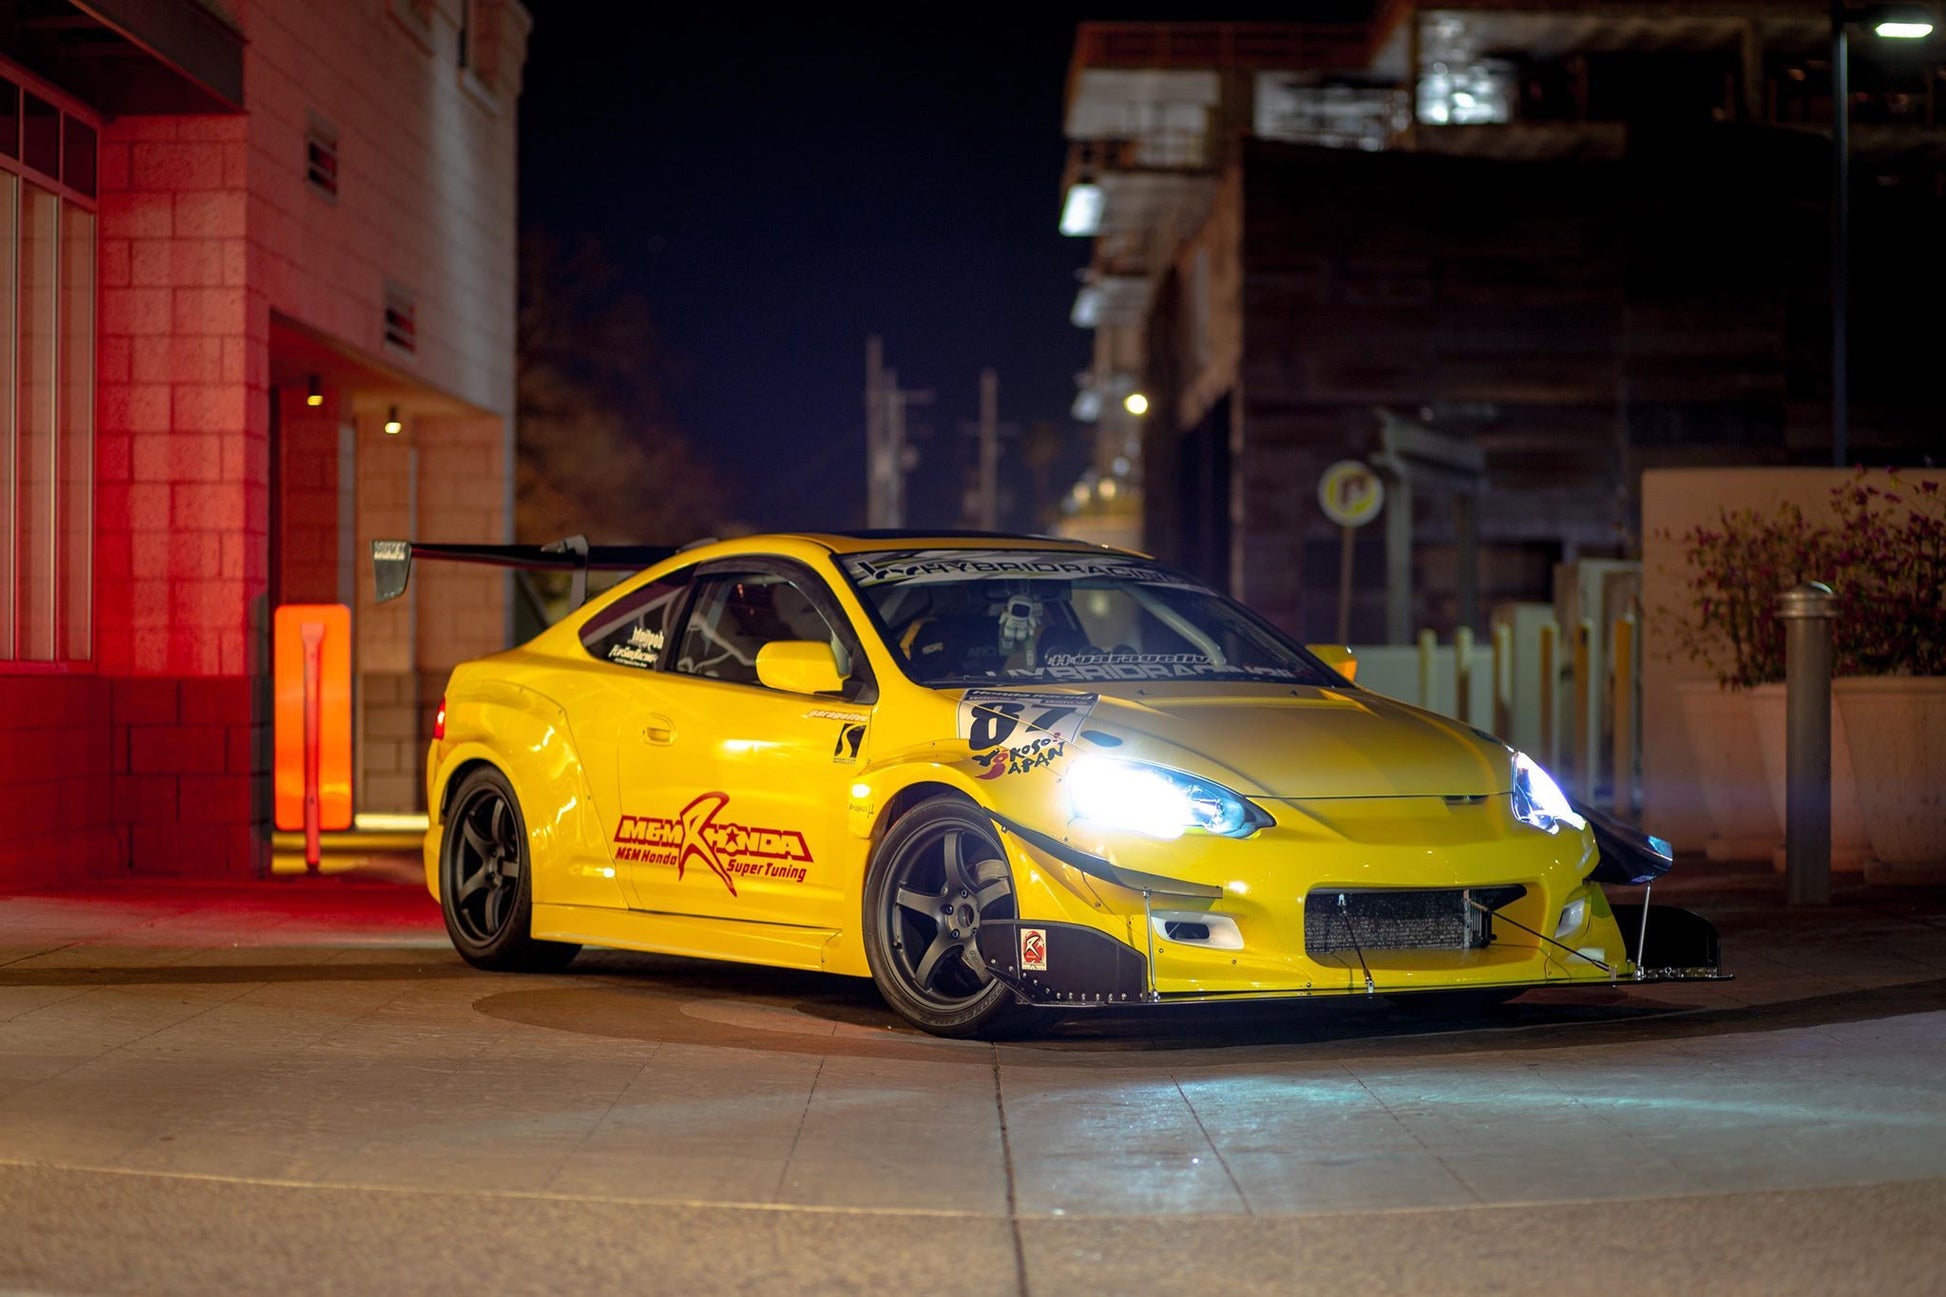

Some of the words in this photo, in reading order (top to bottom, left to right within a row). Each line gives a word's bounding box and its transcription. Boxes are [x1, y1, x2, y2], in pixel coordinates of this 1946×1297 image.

[969, 702, 1077, 751] 87
[641, 849, 678, 866] Honda
[702, 823, 813, 863] HONDA
[726, 859, 764, 877] Super
[764, 862, 808, 883] Tuning
